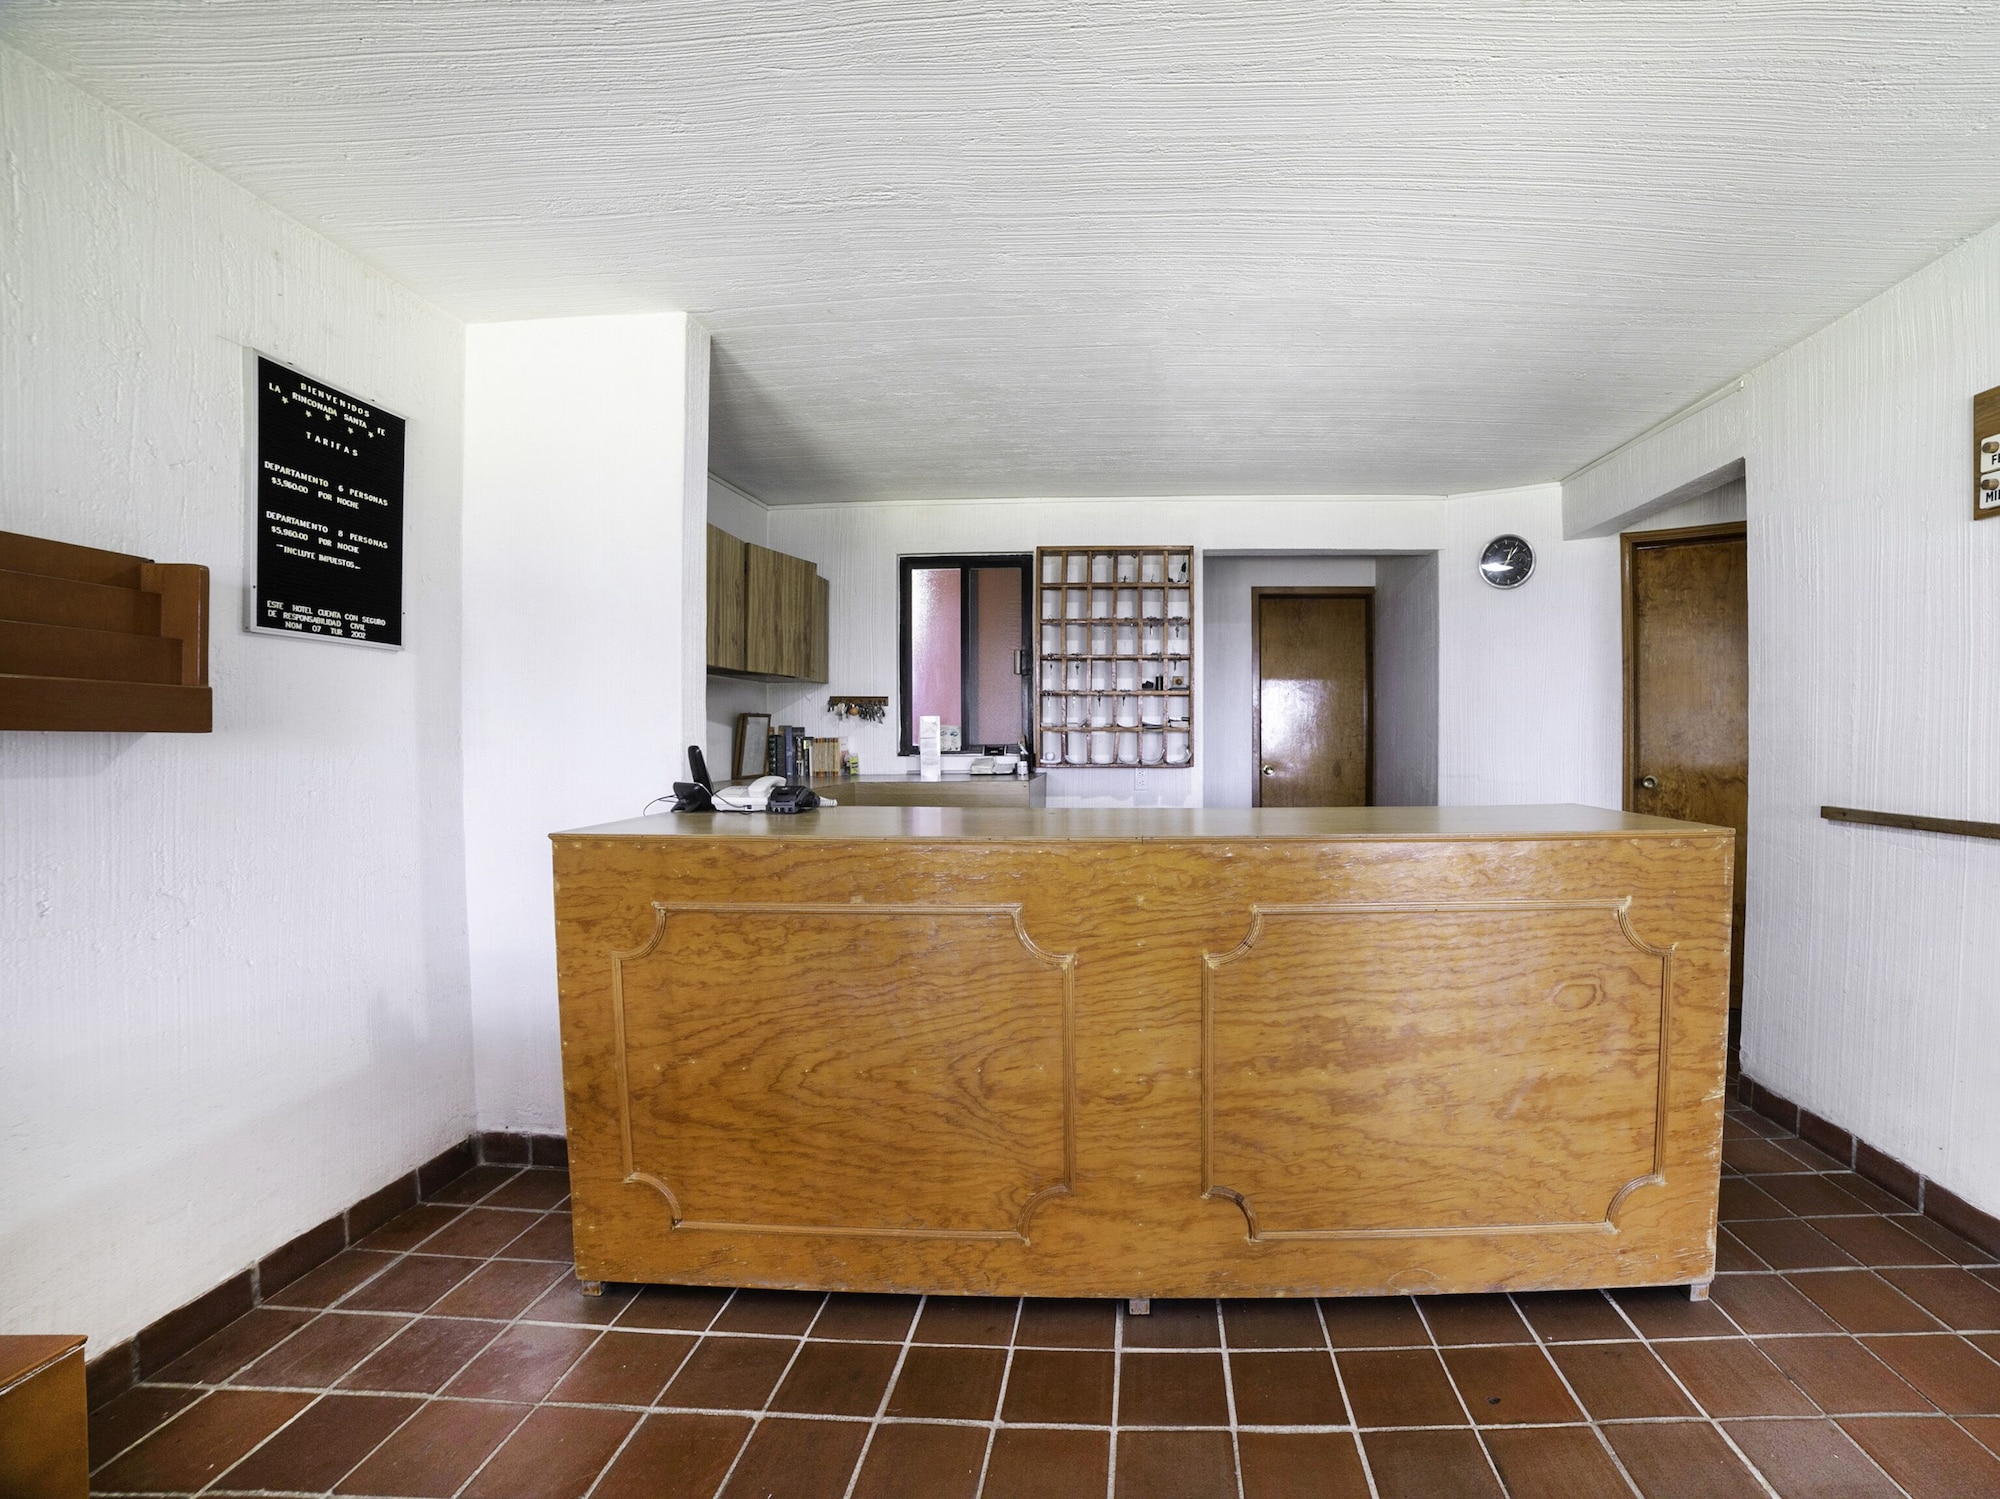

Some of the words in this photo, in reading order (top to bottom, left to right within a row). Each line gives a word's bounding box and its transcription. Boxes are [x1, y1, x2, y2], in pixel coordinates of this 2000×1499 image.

[268, 382, 281, 394] LA
[291, 391, 338, 417] RINCONADA
[343, 413, 367, 429] SANTA
[377, 427, 386, 437] FE
[301, 382, 370, 418] BIENVENIDOS
[305, 431, 358, 457] TARIFAS
[264, 461, 329, 488] DEPARTAMENTO
[338, 484, 344, 493] 6
[349, 488, 389, 507] PERSONAS
[317, 491, 333, 502] POR
[336, 496, 360, 510] NOCHE
[266, 510, 329, 533] DEPARTAMENTO
[337, 530, 344, 538] 8
[349, 533, 389, 549] PERSONAS
[318, 537, 333, 547] POR
[336, 542, 360, 554] NOCHE
[266, 600, 284, 611] ESTE
[292, 604, 313, 615] HOTEL
[317, 608, 341, 619] CUENTA
[344, 613, 358, 622] CON
[361, 616, 387, 627] SEGURO
[267, 609, 278, 618] DE
[282, 611, 342, 628] RESPONSABILIDAD
[349, 622, 366, 631] CIVIL
[284, 620, 303, 631] NOM
[311, 625, 322, 633] 07
[330, 627, 343, 636] TUR
[350, 630, 367, 640] 2002
